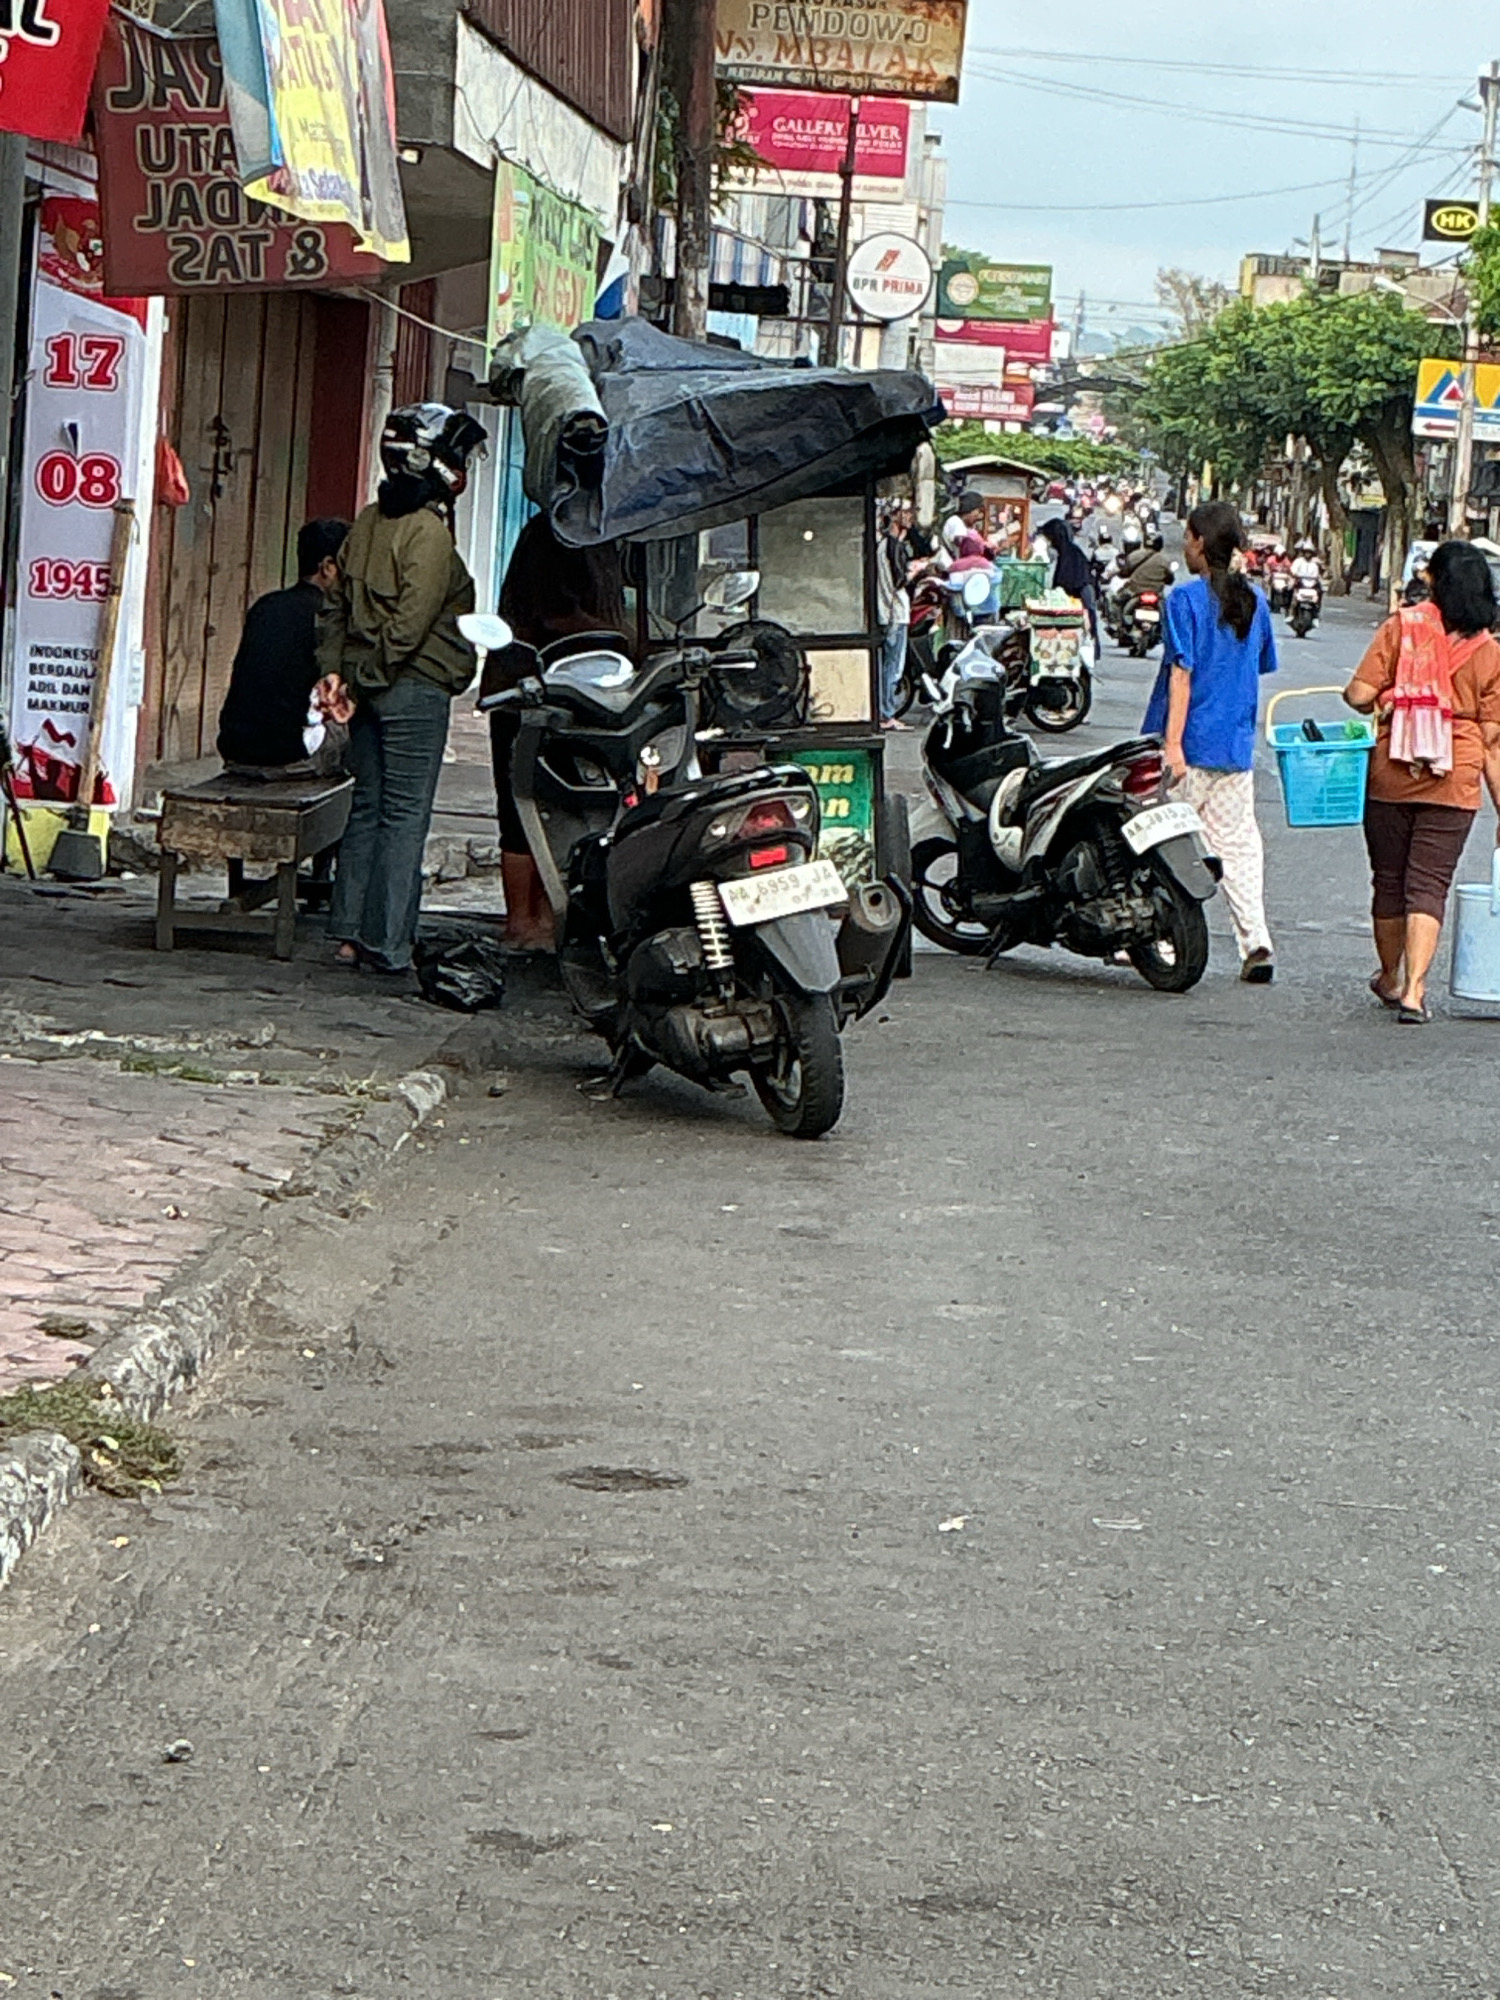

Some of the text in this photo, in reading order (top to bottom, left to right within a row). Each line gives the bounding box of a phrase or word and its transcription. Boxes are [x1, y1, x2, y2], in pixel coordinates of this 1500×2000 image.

[750, 3, 932, 45] PENDOWO
[773, 116, 846, 138] GALLERY
[855, 123, 902, 141] ILVER
[1439, 213, 1472, 229] HK
[852, 276, 923, 295] BPR PRIMA
[44, 332, 124, 391] 17
[35, 450, 121, 508] 08
[28, 557, 111, 602] 1945
[27, 680, 90, 696] ADIL DAN
[27, 697, 90, 714] MAKMUR
[756, 872, 801, 897] 6959
